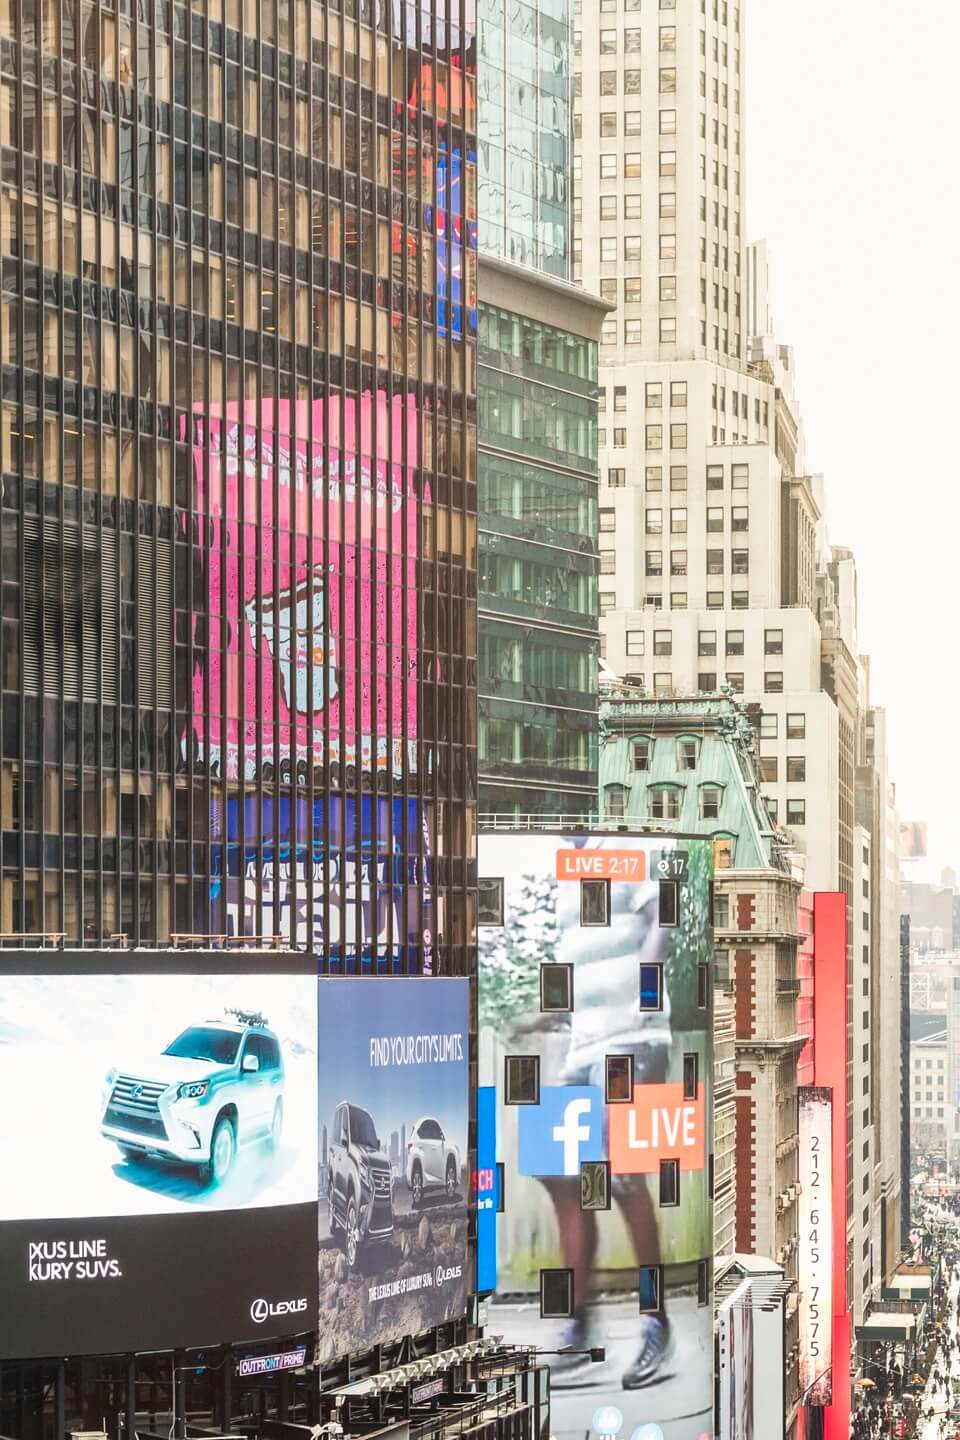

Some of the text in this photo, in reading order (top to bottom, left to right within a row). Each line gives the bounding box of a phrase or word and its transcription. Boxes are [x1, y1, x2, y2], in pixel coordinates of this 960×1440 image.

[564, 857, 685, 875] LIVE 2:17 17
[370, 1037, 389, 1067] FIND
[390, 1036, 414, 1065] YOUR
[628, 1106, 696, 1149] LIVE
[69, 1239, 106, 1258] LINE
[442, 1265, 462, 1281] LEXUS
[269, 1298, 308, 1316] LEXUS
[242, 1352, 304, 1373] OUTFRONT PRIME
